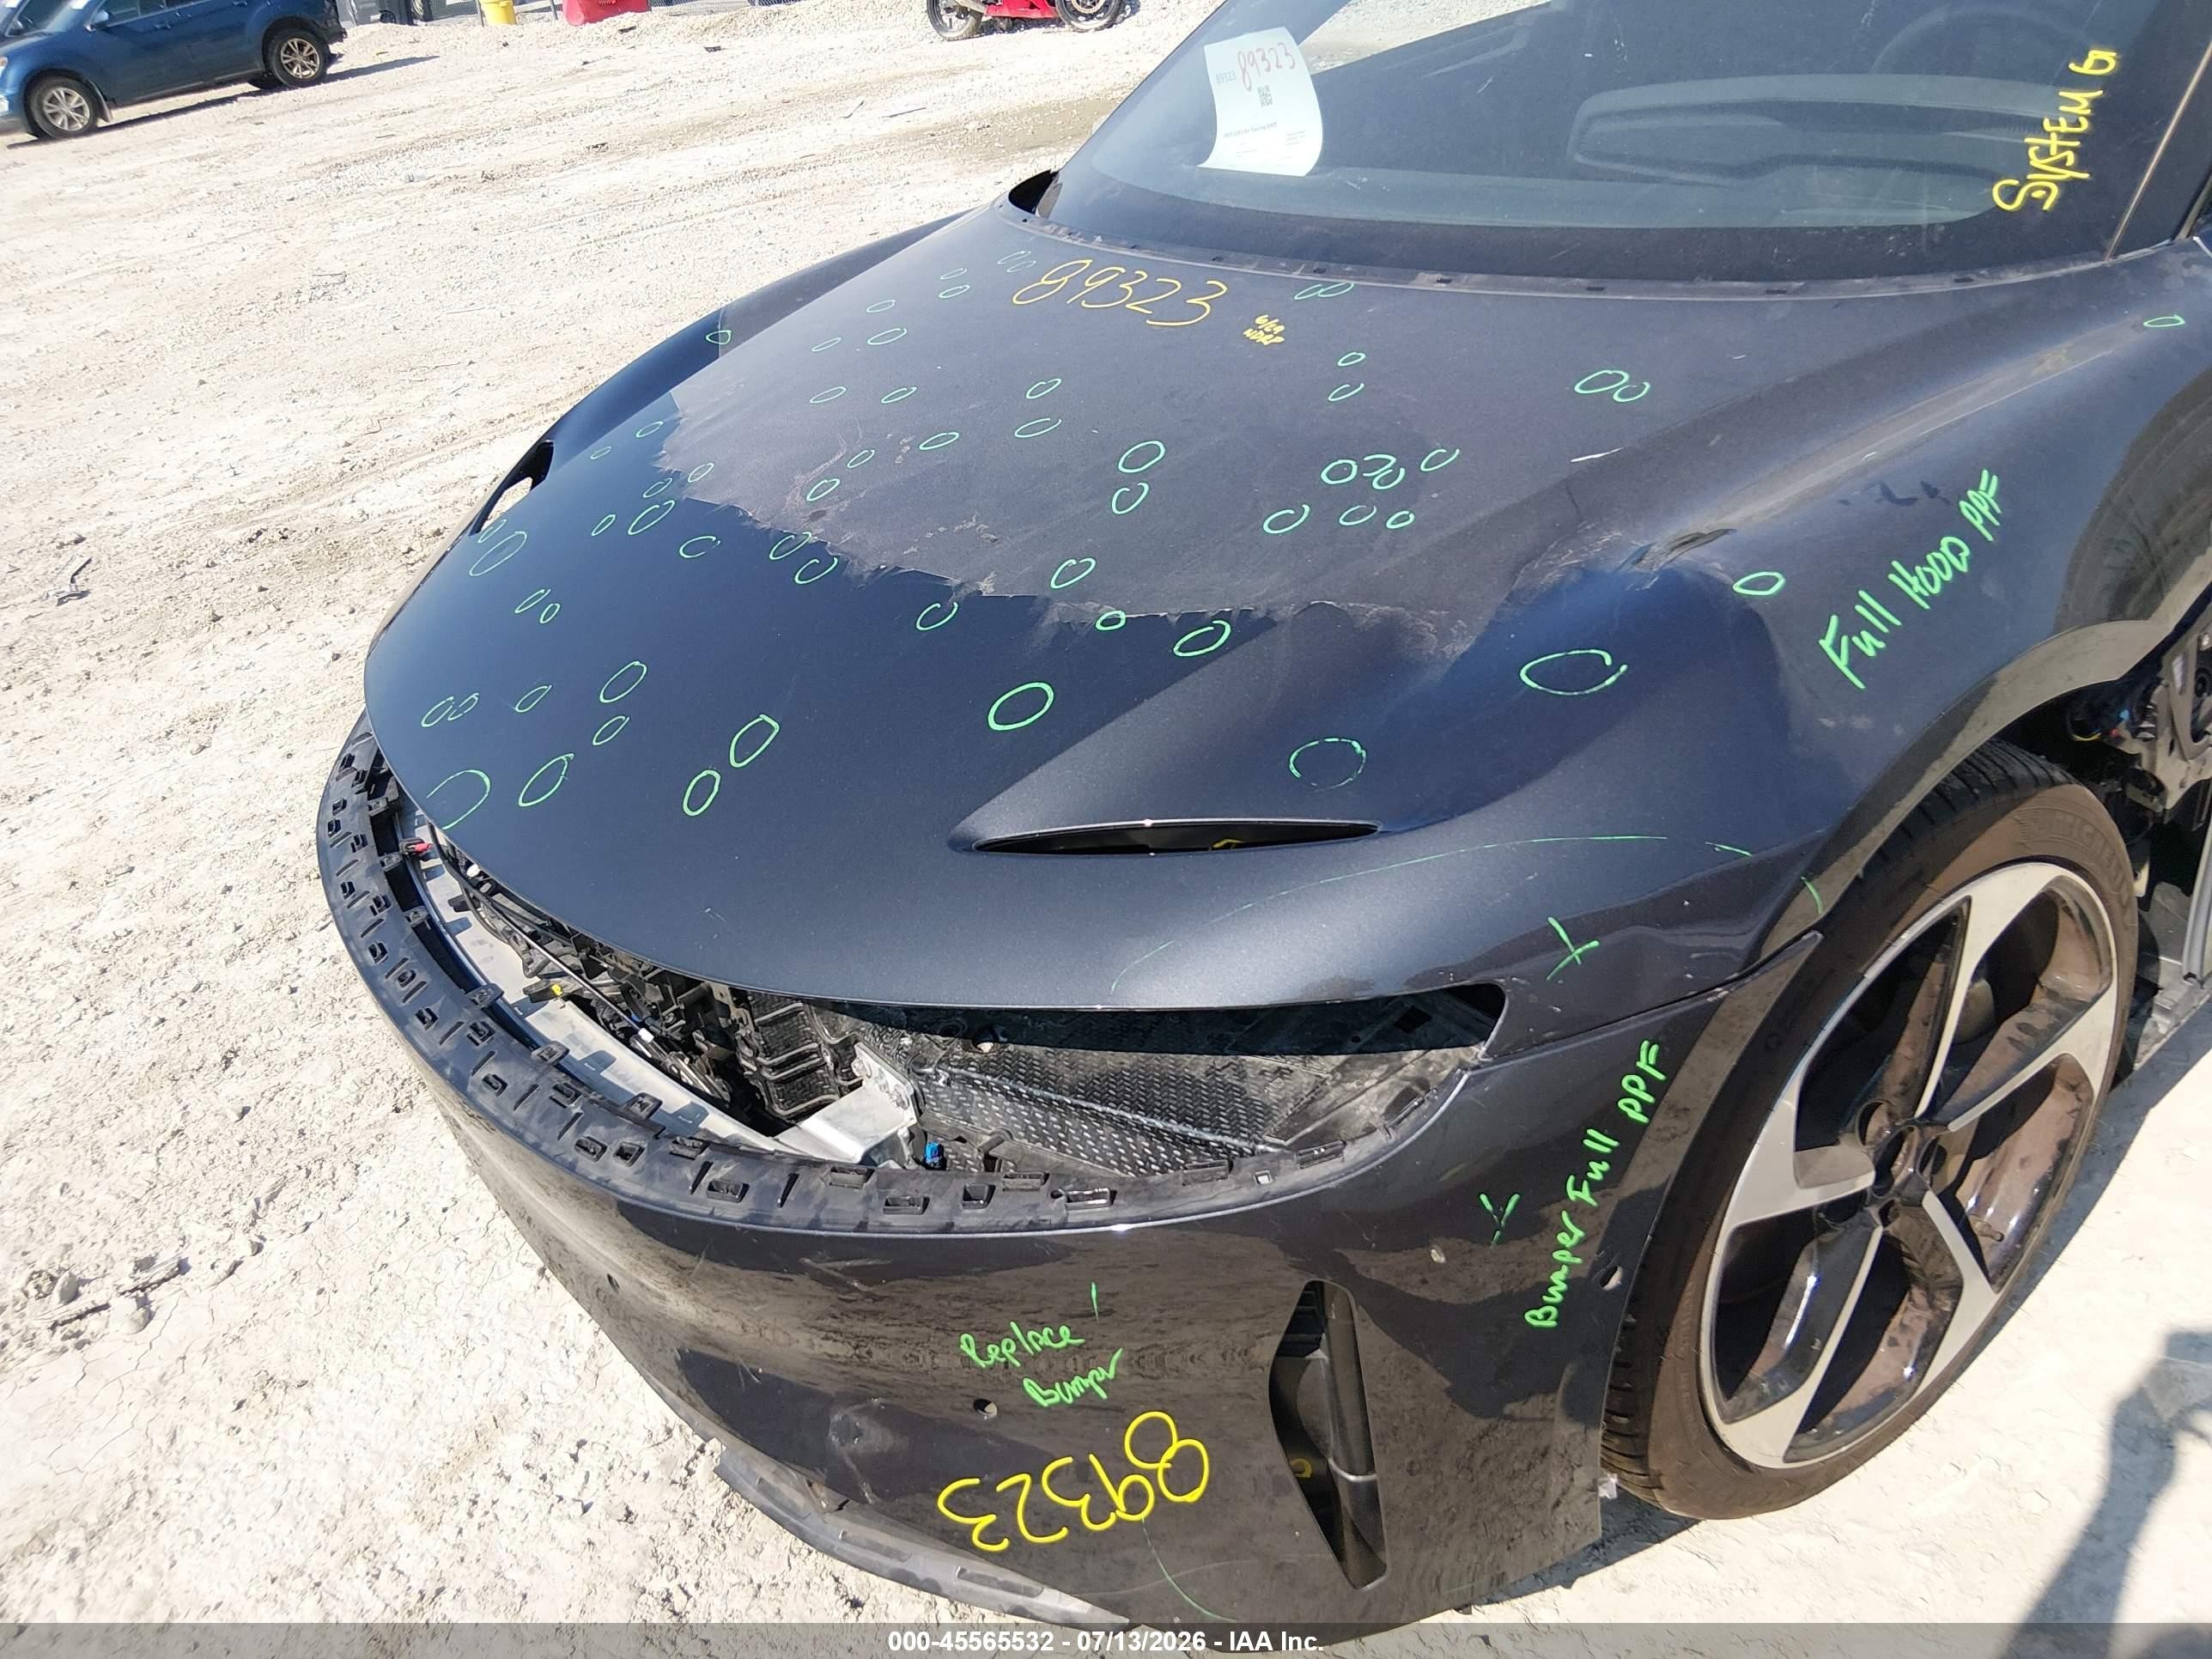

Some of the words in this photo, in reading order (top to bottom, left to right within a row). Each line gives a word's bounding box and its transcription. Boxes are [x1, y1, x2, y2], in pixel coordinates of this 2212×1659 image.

[1237, 41, 1296, 93] 89323
[1012, 258, 1229, 326] 89323
[1818, 589, 1903, 690] Full
[1959, 468, 2002, 543] PPF
[1523, 1210, 1586, 1328] Bumper
[1565, 1127, 1620, 1208] Full
[959, 1321, 1086, 1369] Replace
[937, 1410, 1210, 1553] 89323
